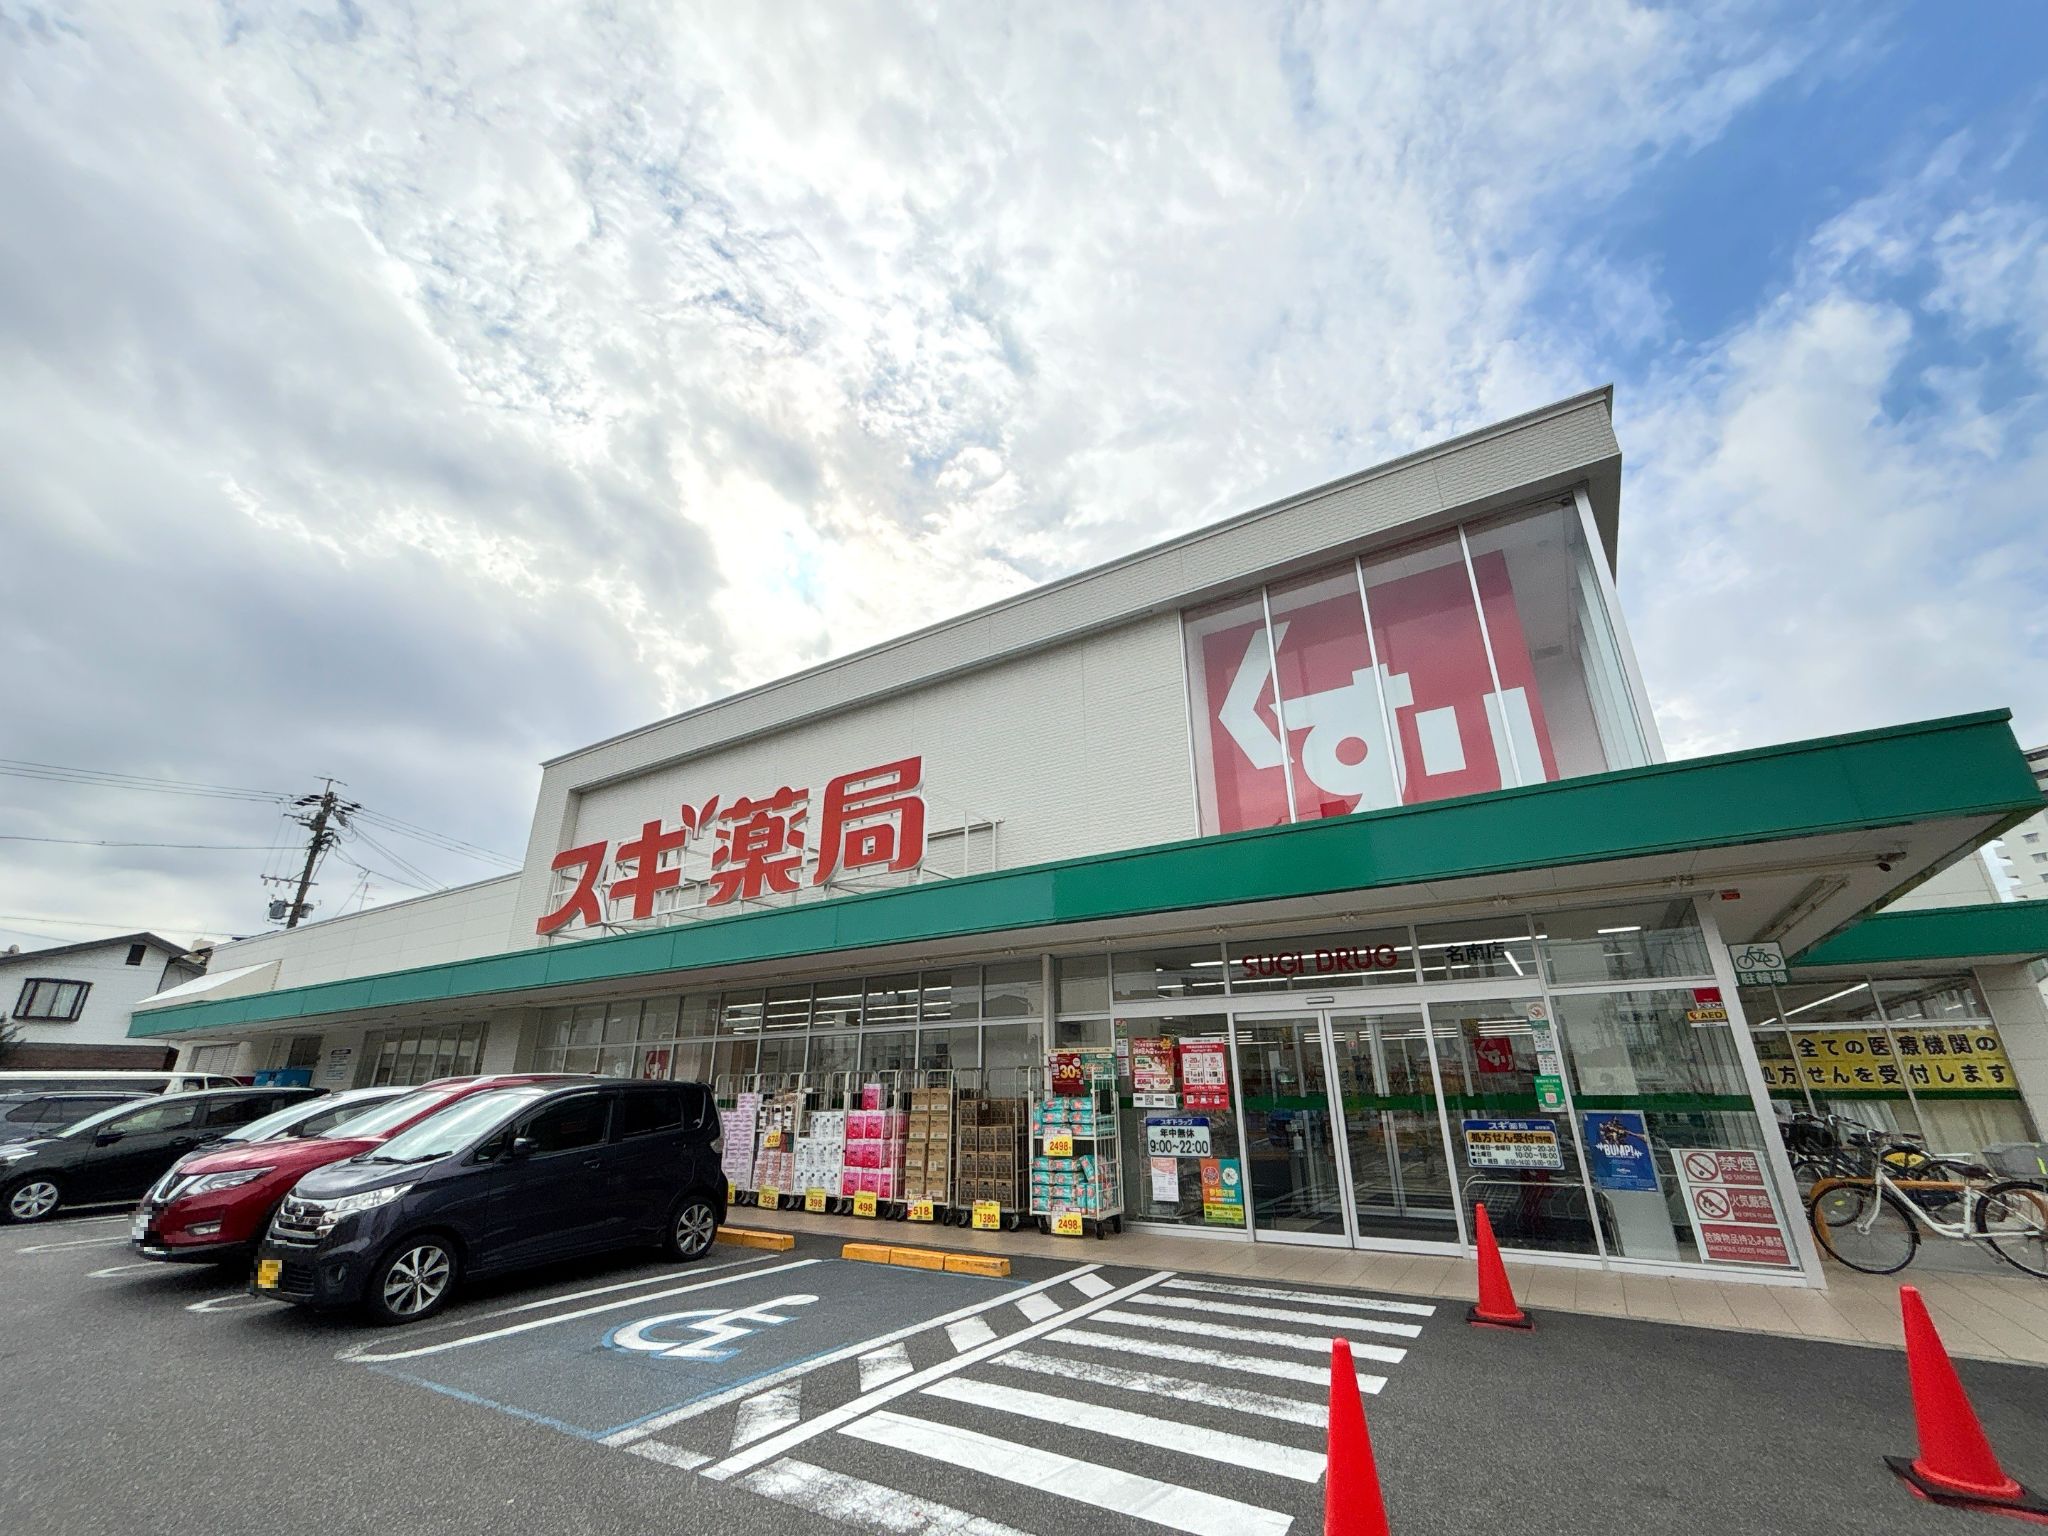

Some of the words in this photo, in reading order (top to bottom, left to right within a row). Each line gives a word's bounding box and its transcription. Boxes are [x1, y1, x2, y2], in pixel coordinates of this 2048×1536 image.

[1218, 621, 1547, 813] くすり
[536, 755, 928, 936] スギ薬局
[1446, 941, 1505, 964] 名南店
[1242, 951, 1305, 977] SUGI
[1315, 943, 1398, 973] DRUG
[1740, 971, 1788, 985] 駐輪場
[1797, 1033, 1998, 1057] 全ての医療機関の
[1762, 1063, 2006, 1085] 処方せんを受付します
[1488, 1121, 1528, 1130] スギ薬局
[1160, 1128, 1195, 1138] 年中無休
[1049, 1141, 1069, 1151] 2498
[1604, 1143, 1634, 1158] BUMP!
[1719, 1155, 1760, 1173] 禁煙
[762, 1195, 775, 1205] 328
[809, 1198, 822, 1208] 398
[1729, 1193, 1772, 1209] 火気厳禁
[858, 1203, 874, 1213] 498
[913, 1206, 930, 1216] 518
[979, 1214, 996, 1224] 1380
[1058, 1219, 1078, 1230] 2498
